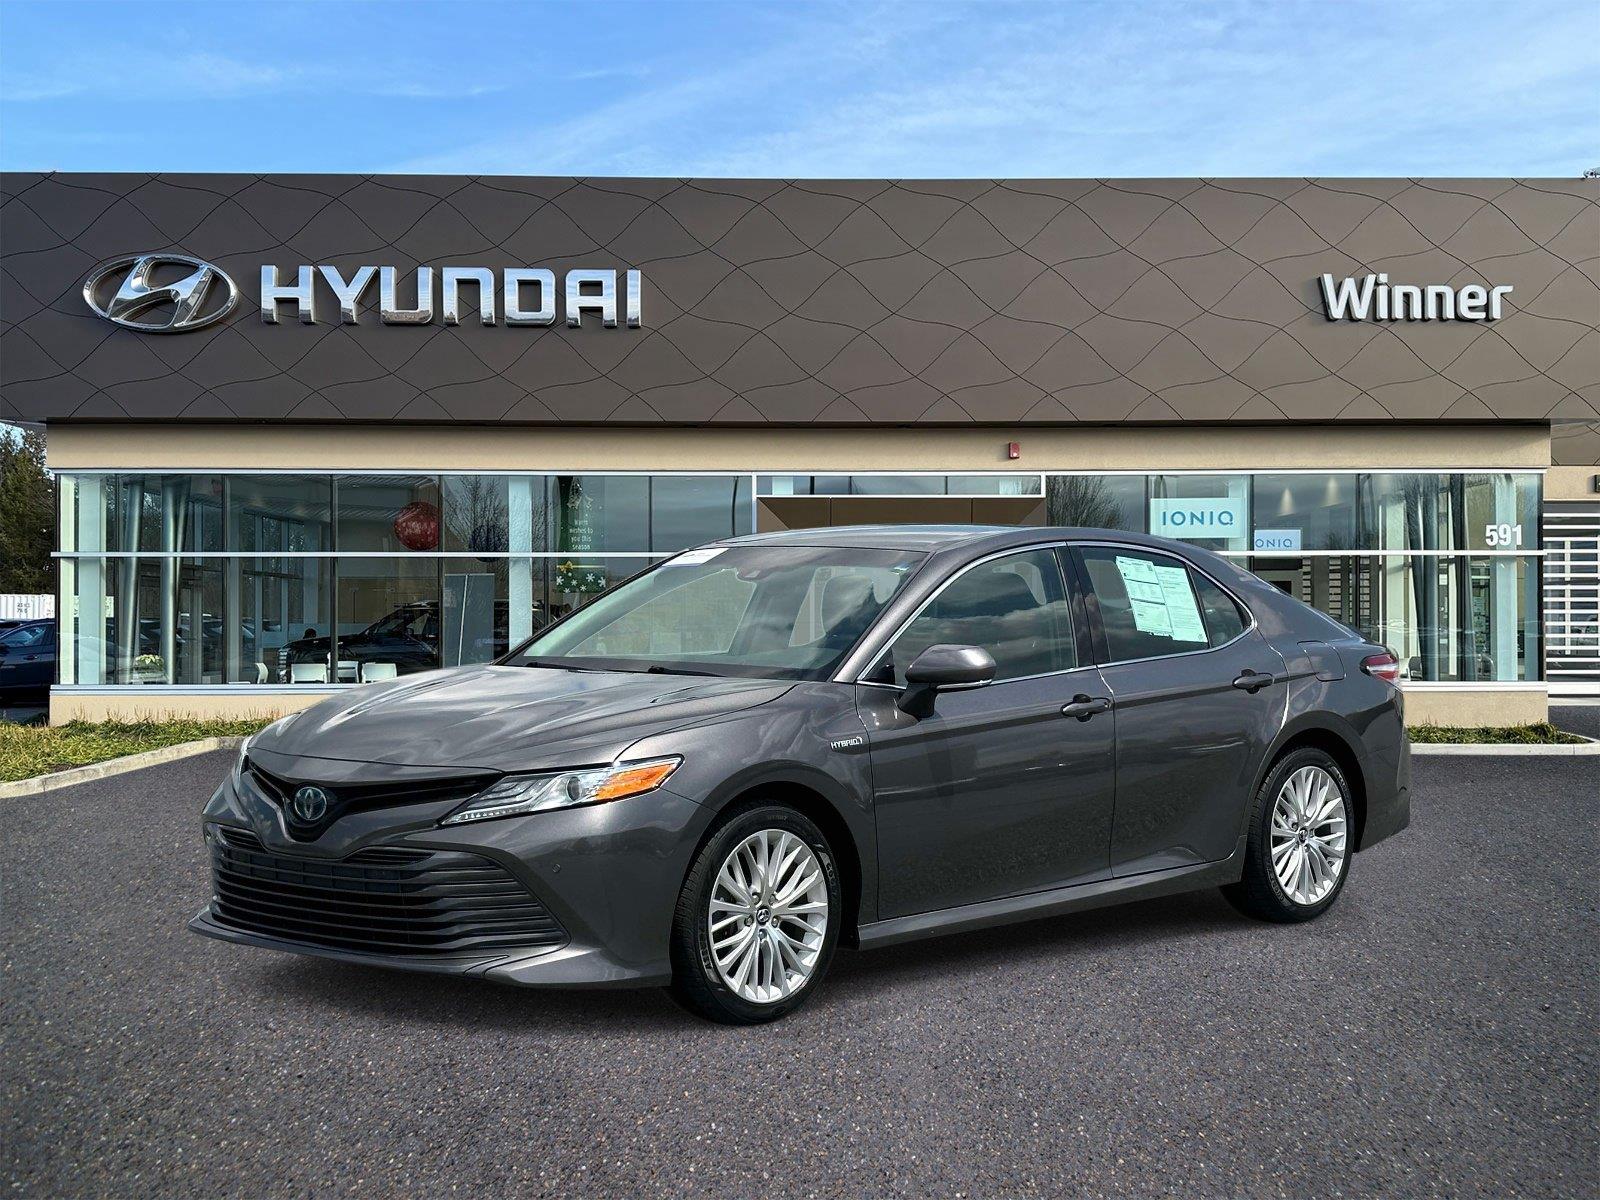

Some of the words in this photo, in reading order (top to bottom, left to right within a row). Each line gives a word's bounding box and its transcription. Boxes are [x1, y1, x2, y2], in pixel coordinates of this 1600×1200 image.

[260, 265, 641, 329] HYUNDAI
[1320, 273, 1514, 321] Winner
[1162, 510, 1234, 526] IONIQ
[1255, 538, 1293, 548] ONIQ
[1485, 523, 1522, 546] 591
[830, 738, 860, 749] HYBRID
